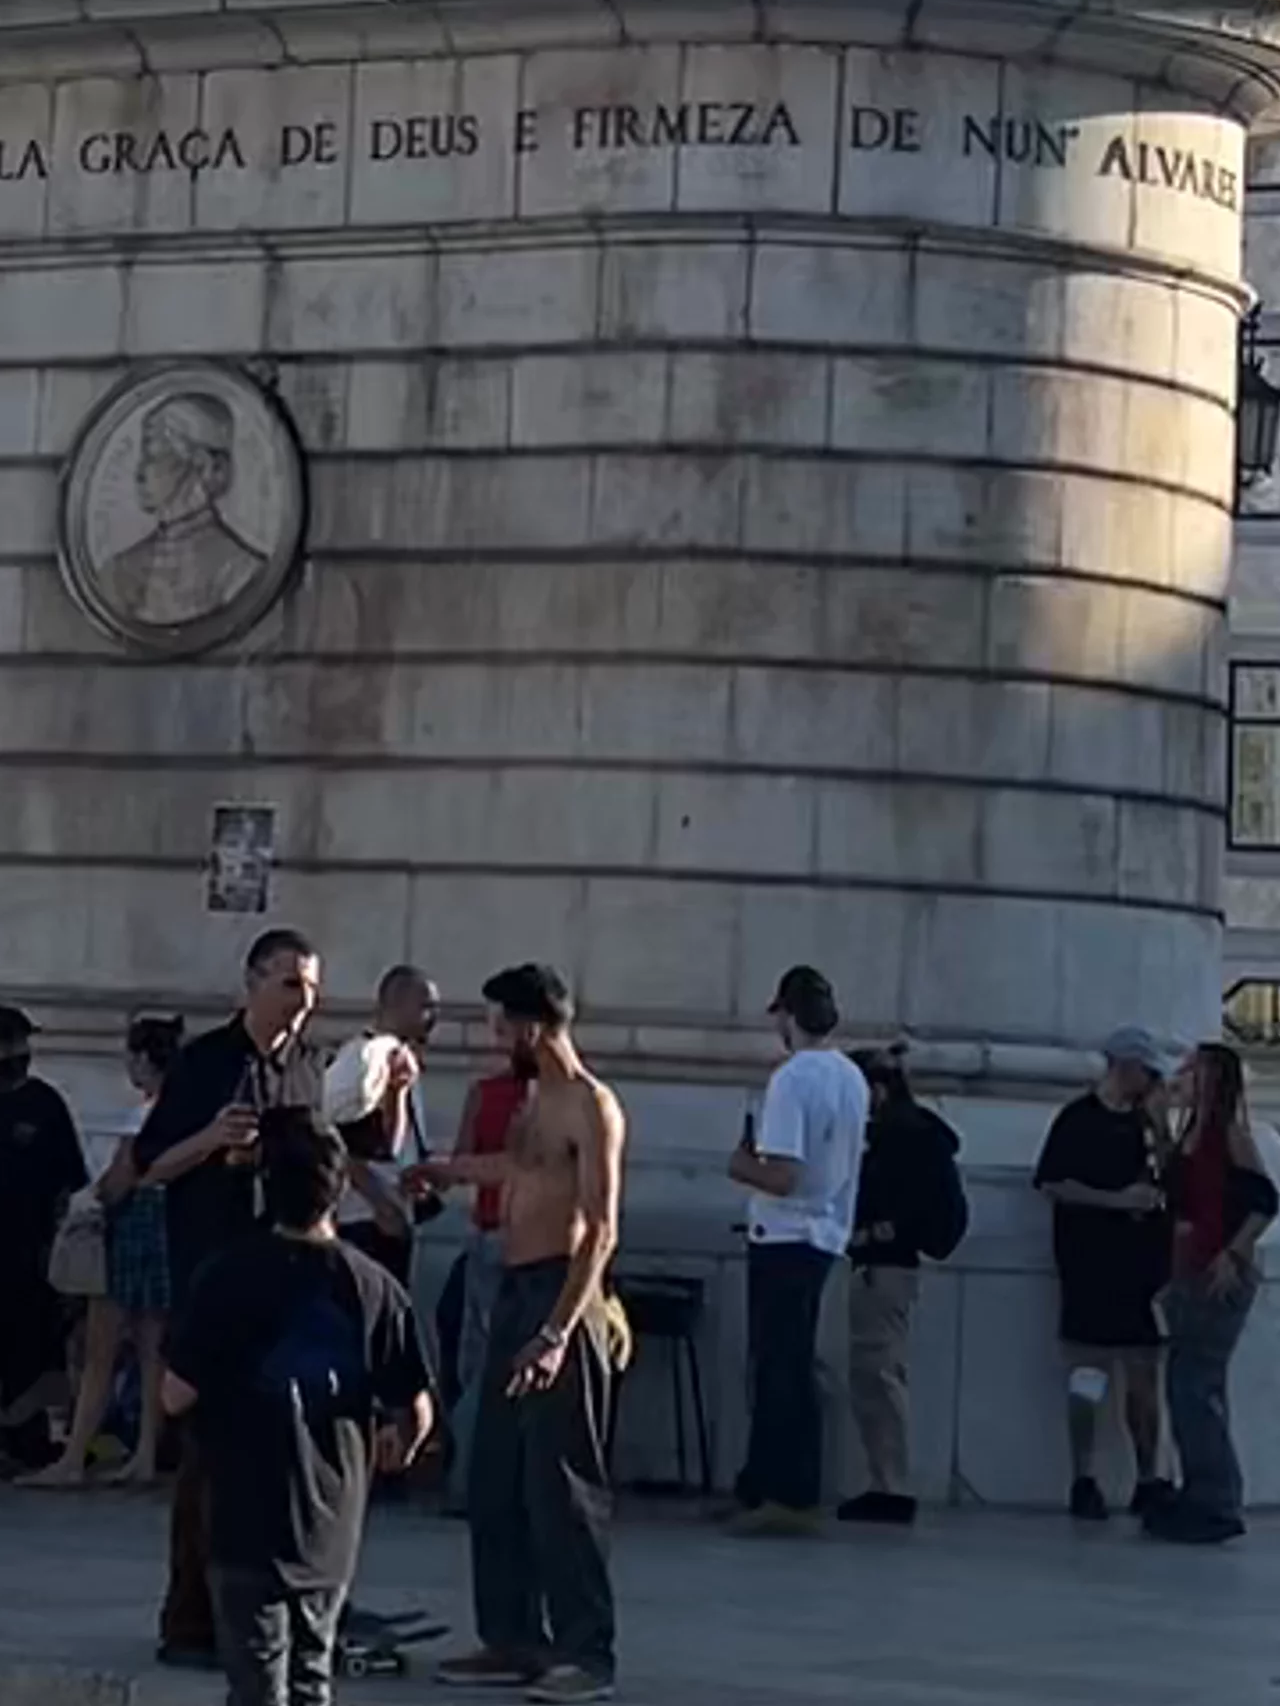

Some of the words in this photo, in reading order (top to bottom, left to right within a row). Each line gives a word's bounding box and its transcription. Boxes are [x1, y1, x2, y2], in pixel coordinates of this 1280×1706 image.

[79, 129, 244, 182] GRAÇA
[280, 123, 338, 166] DE
[370, 115, 479, 160] DEUS
[515, 110, 539, 153] E
[573, 101, 801, 148] FIRMEZA
[851, 106, 922, 152] DE
